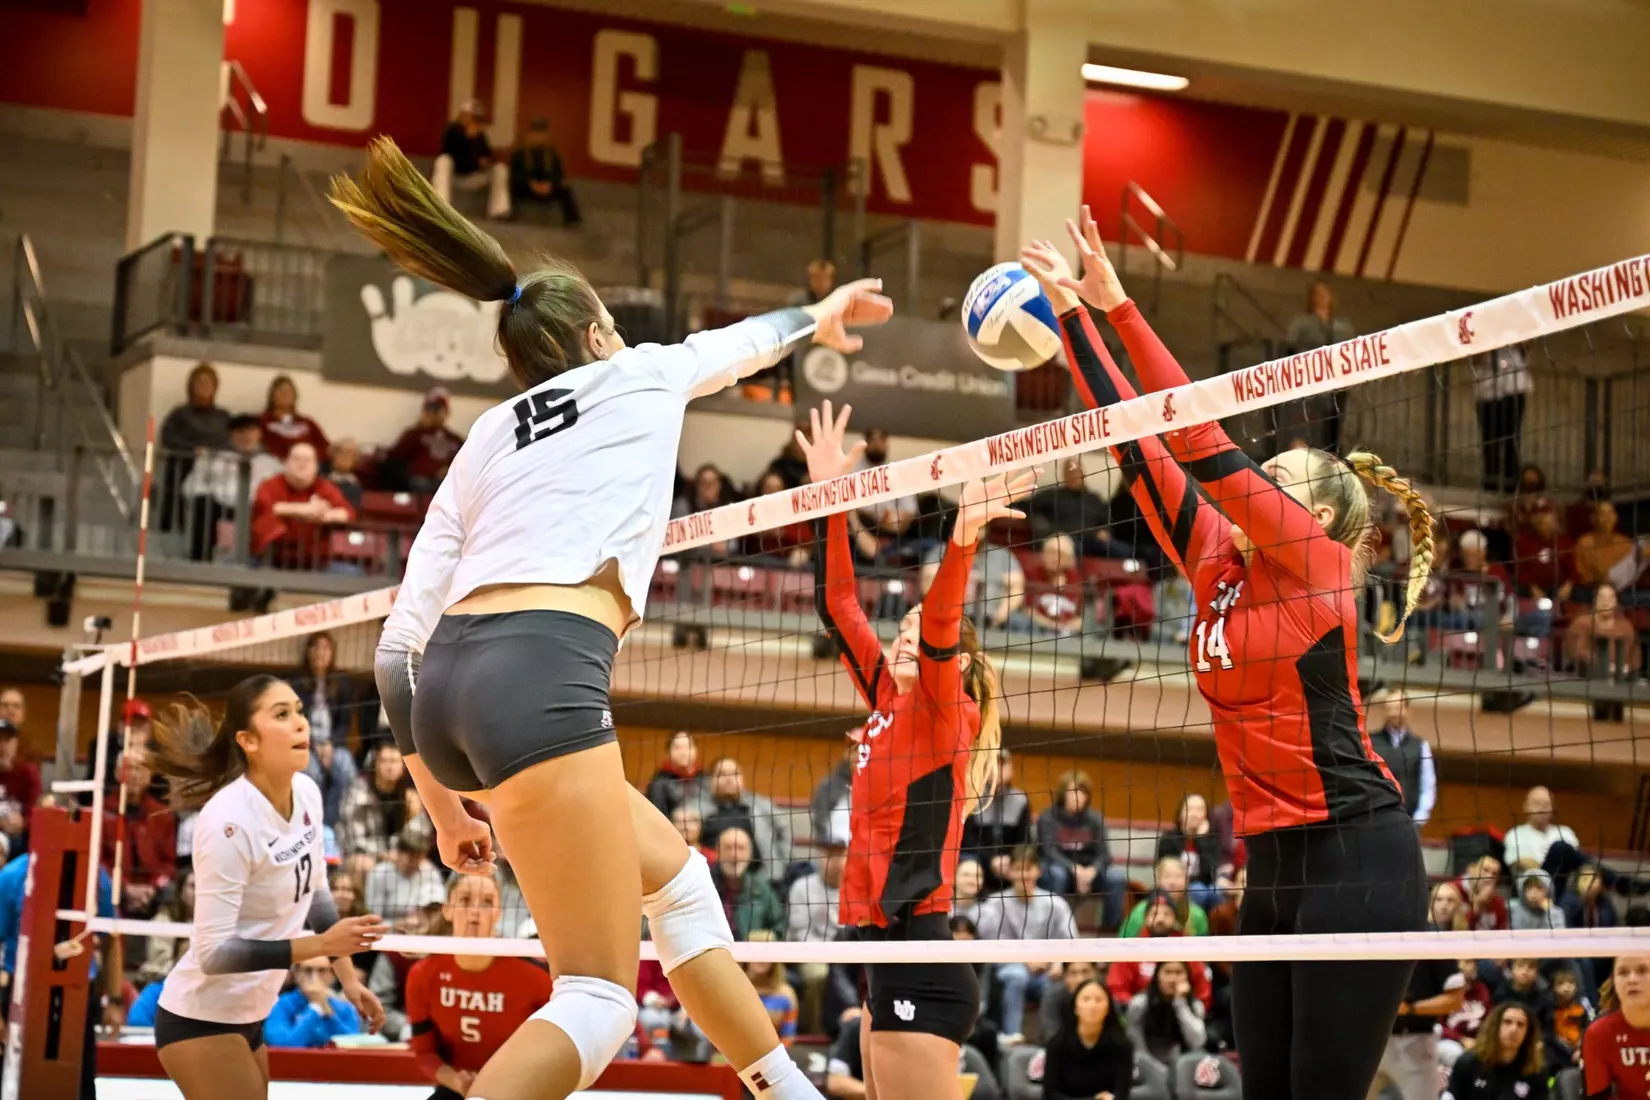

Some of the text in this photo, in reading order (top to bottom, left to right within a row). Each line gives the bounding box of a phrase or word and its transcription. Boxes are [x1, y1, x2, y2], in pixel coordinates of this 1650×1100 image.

[220, 0, 1000, 214] OUGARS
[1231, 332, 1390, 403] WASHINGTON STATE
[513, 388, 579, 451] 15
[987, 408, 1110, 467] WASHINGTON STATE
[791, 466, 891, 515] WASHINGTON STATE
[688, 511, 714, 540] STATE
[1196, 616, 1234, 672] 14
[294, 853, 312, 903] 12
[440, 986, 504, 1012] UTAH
[461, 1016, 481, 1043] 5
[1620, 1047, 1650, 1066] UT
